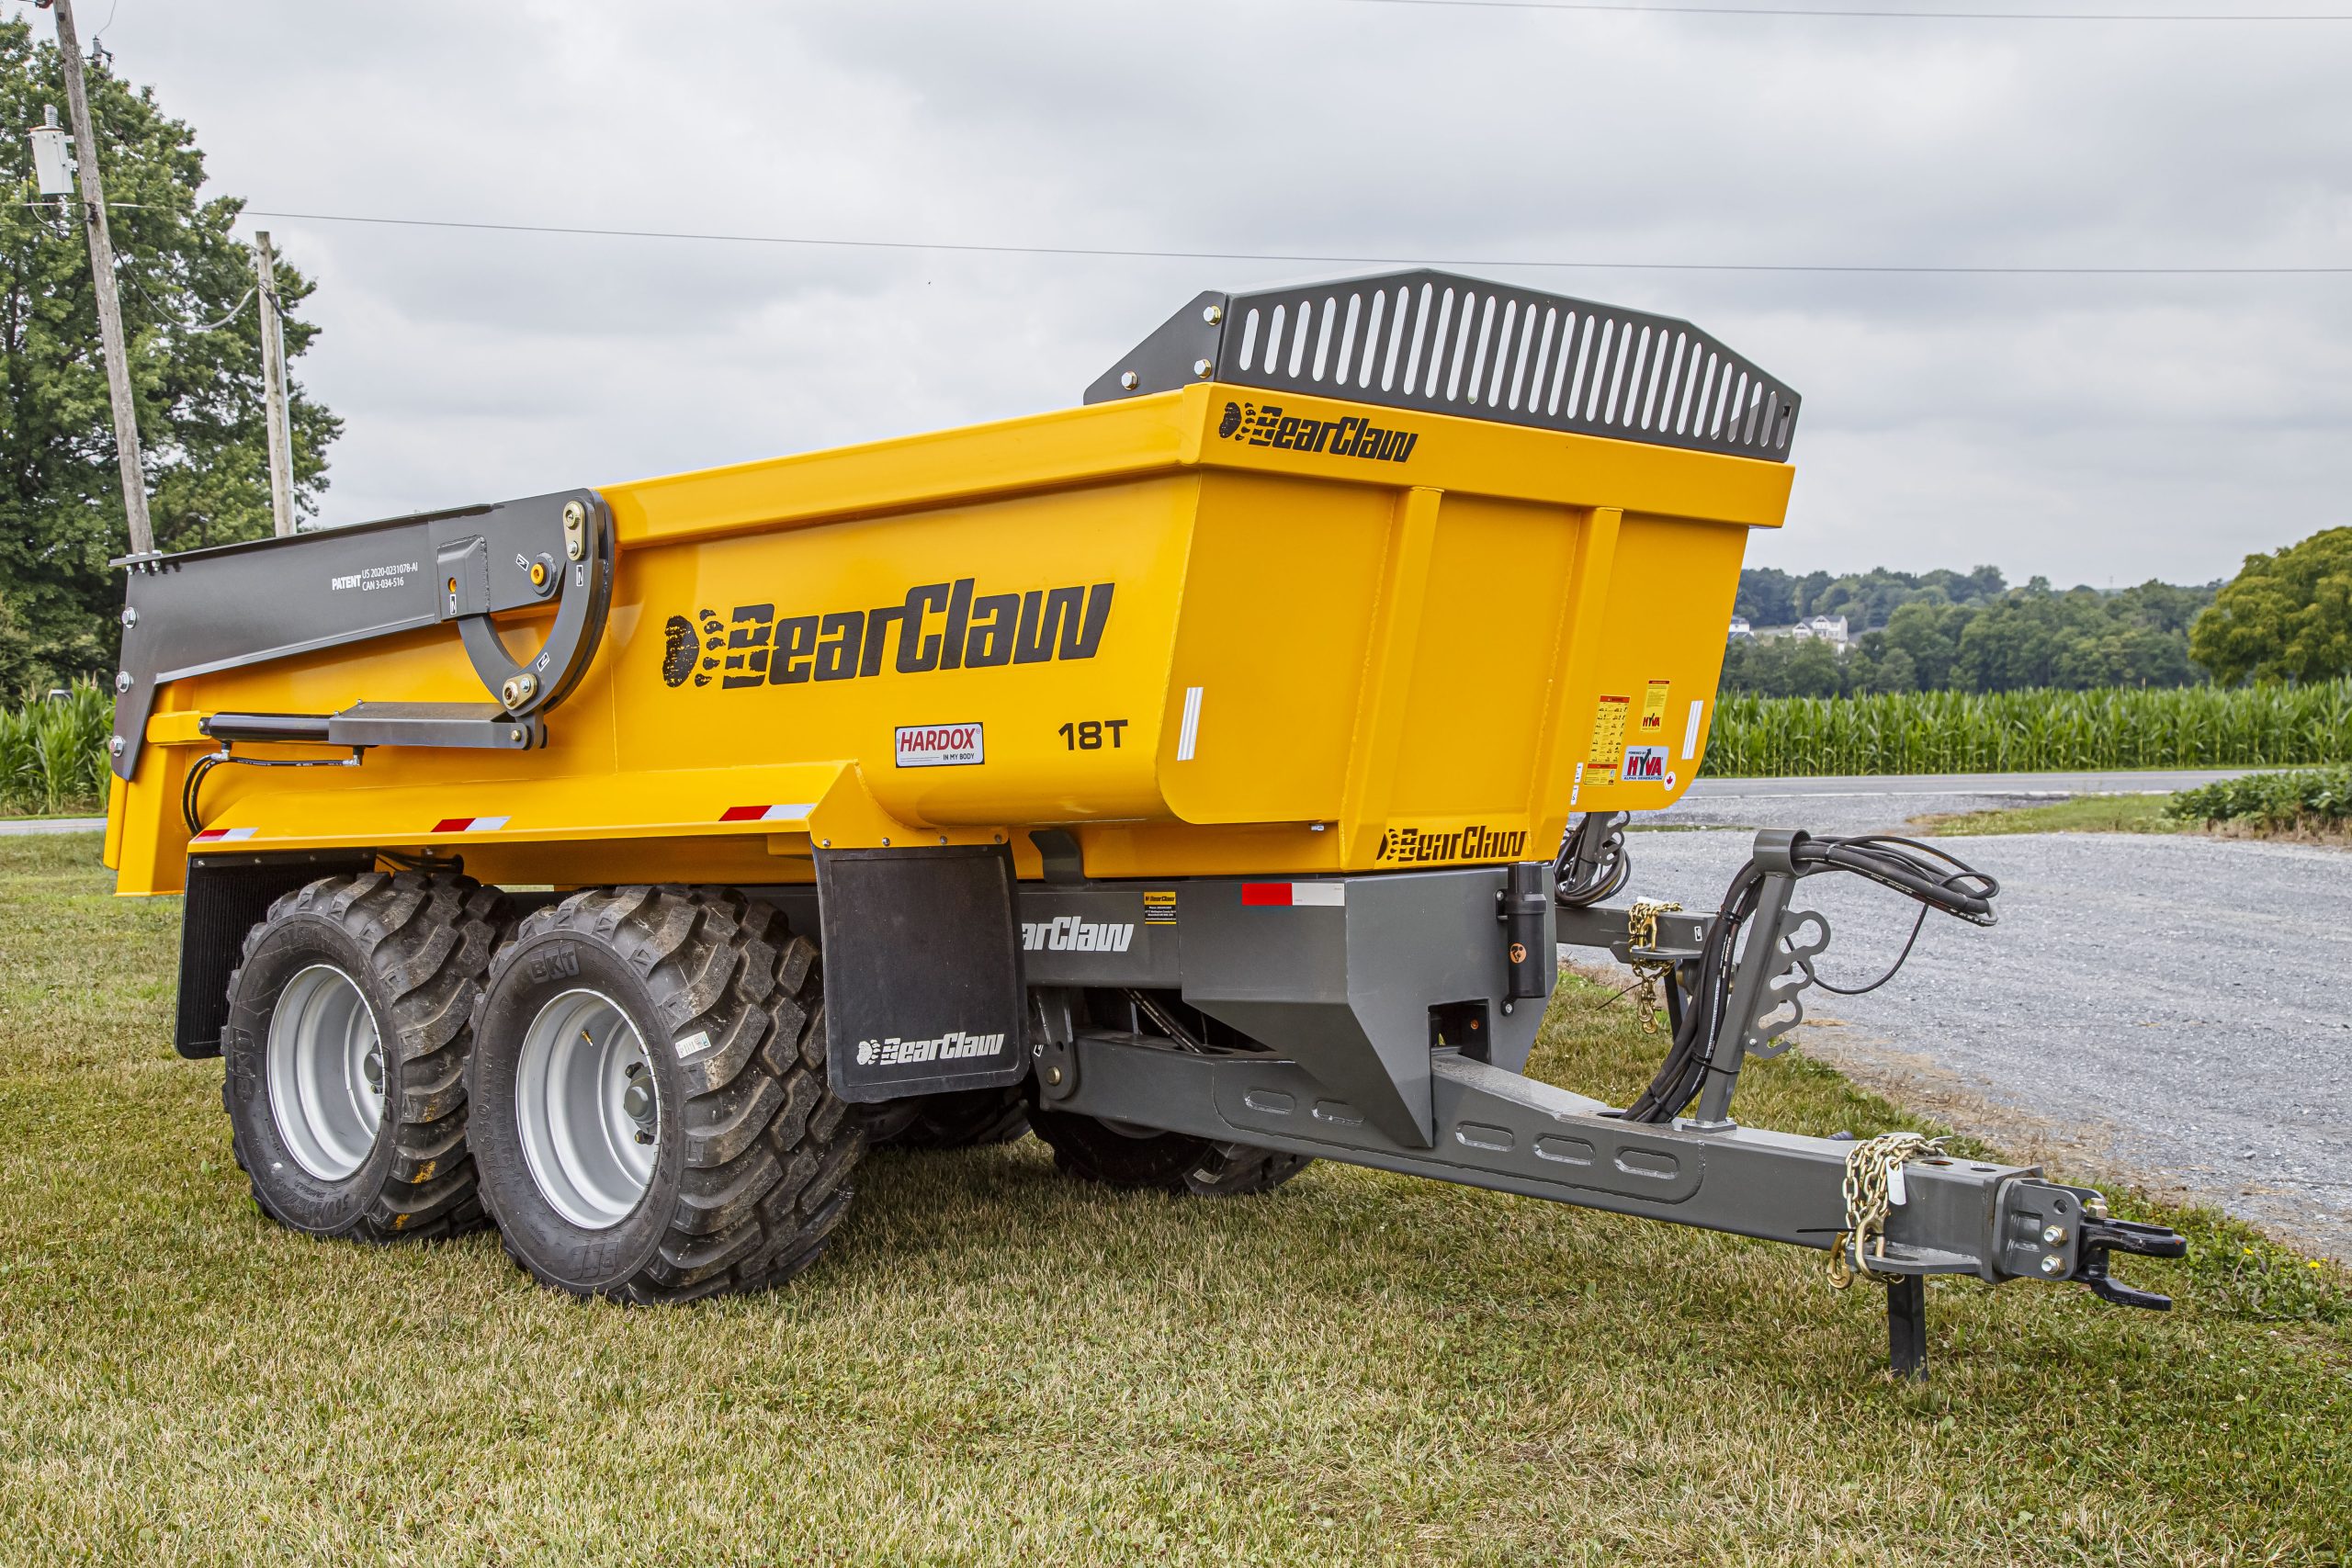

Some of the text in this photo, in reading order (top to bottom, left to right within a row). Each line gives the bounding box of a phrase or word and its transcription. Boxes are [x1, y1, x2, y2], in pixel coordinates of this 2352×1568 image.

[1249, 405, 1419, 463] BearClaw
[332, 574, 362, 591] PATENT
[362, 569, 370, 579] US
[362, 577, 404, 592] CAN 3-034-516
[722, 578, 1114, 689] BearClaw
[1642, 713, 1661, 727] HYVA
[900, 728, 976, 752] HARDOX
[1058, 719, 1128, 750] 18T
[1627, 750, 1662, 776] HYVA
[1398, 826, 1527, 862] BearClaw
[529, 947, 577, 981] BKT
[880, 1032, 1005, 1066] BearClaw
